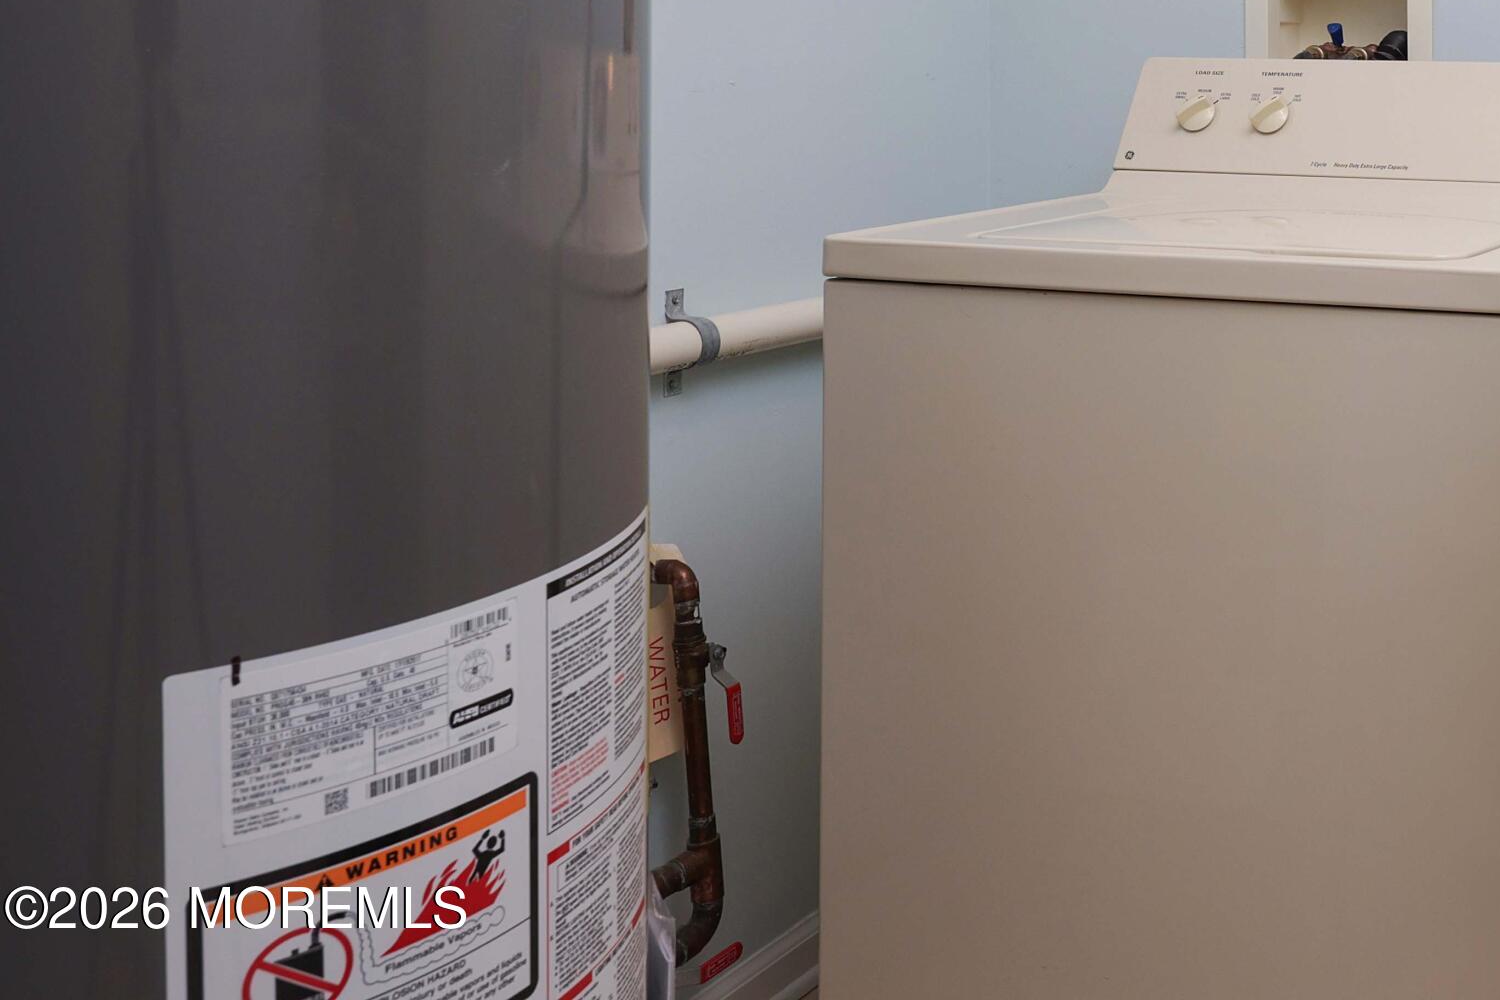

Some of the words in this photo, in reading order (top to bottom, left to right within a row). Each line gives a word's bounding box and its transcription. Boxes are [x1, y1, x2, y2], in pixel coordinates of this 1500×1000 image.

[648, 636, 670, 725] WATER
[346, 826, 458, 880] WARNING
[385, 942, 445, 973] Flammable
[448, 922, 482, 944] Vapors
[427, 959, 466, 985] HAZARD
[438, 982, 446, 991] or
[449, 968, 472, 985] death
[460, 976, 484, 992] vapors
[487, 964, 499, 978] and
[501, 952, 522, 968] liquids
